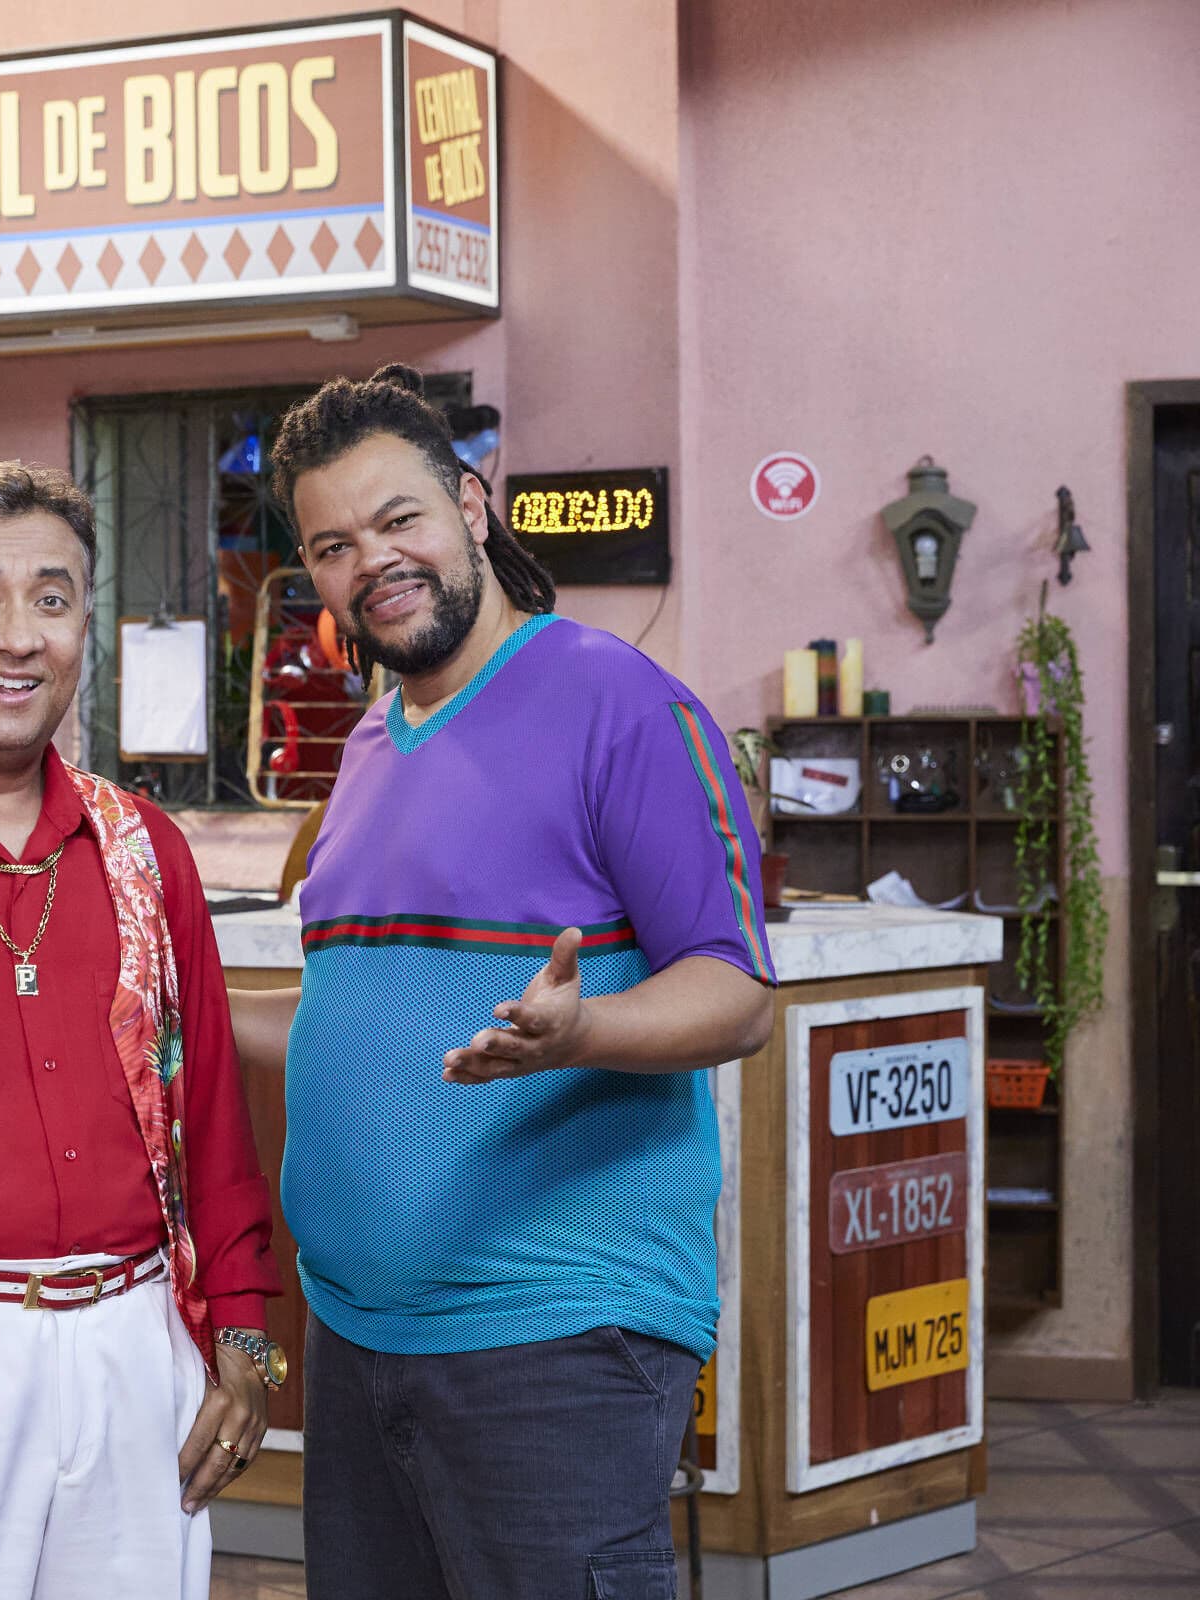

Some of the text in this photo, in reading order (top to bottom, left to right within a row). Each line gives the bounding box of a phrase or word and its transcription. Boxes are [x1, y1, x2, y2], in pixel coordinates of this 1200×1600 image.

[43, 96, 107, 191] DE
[124, 56, 338, 205] BICOS
[415, 67, 482, 144] CENTRAL
[424, 132, 485, 206] DE BICOS
[511, 488, 654, 534] OBRIGADO
[18, 969, 34, 990] P
[846, 1060, 951, 1125] VF-3250
[844, 1171, 953, 1244] XL-1852
[874, 1311, 963, 1374] MJM 725
